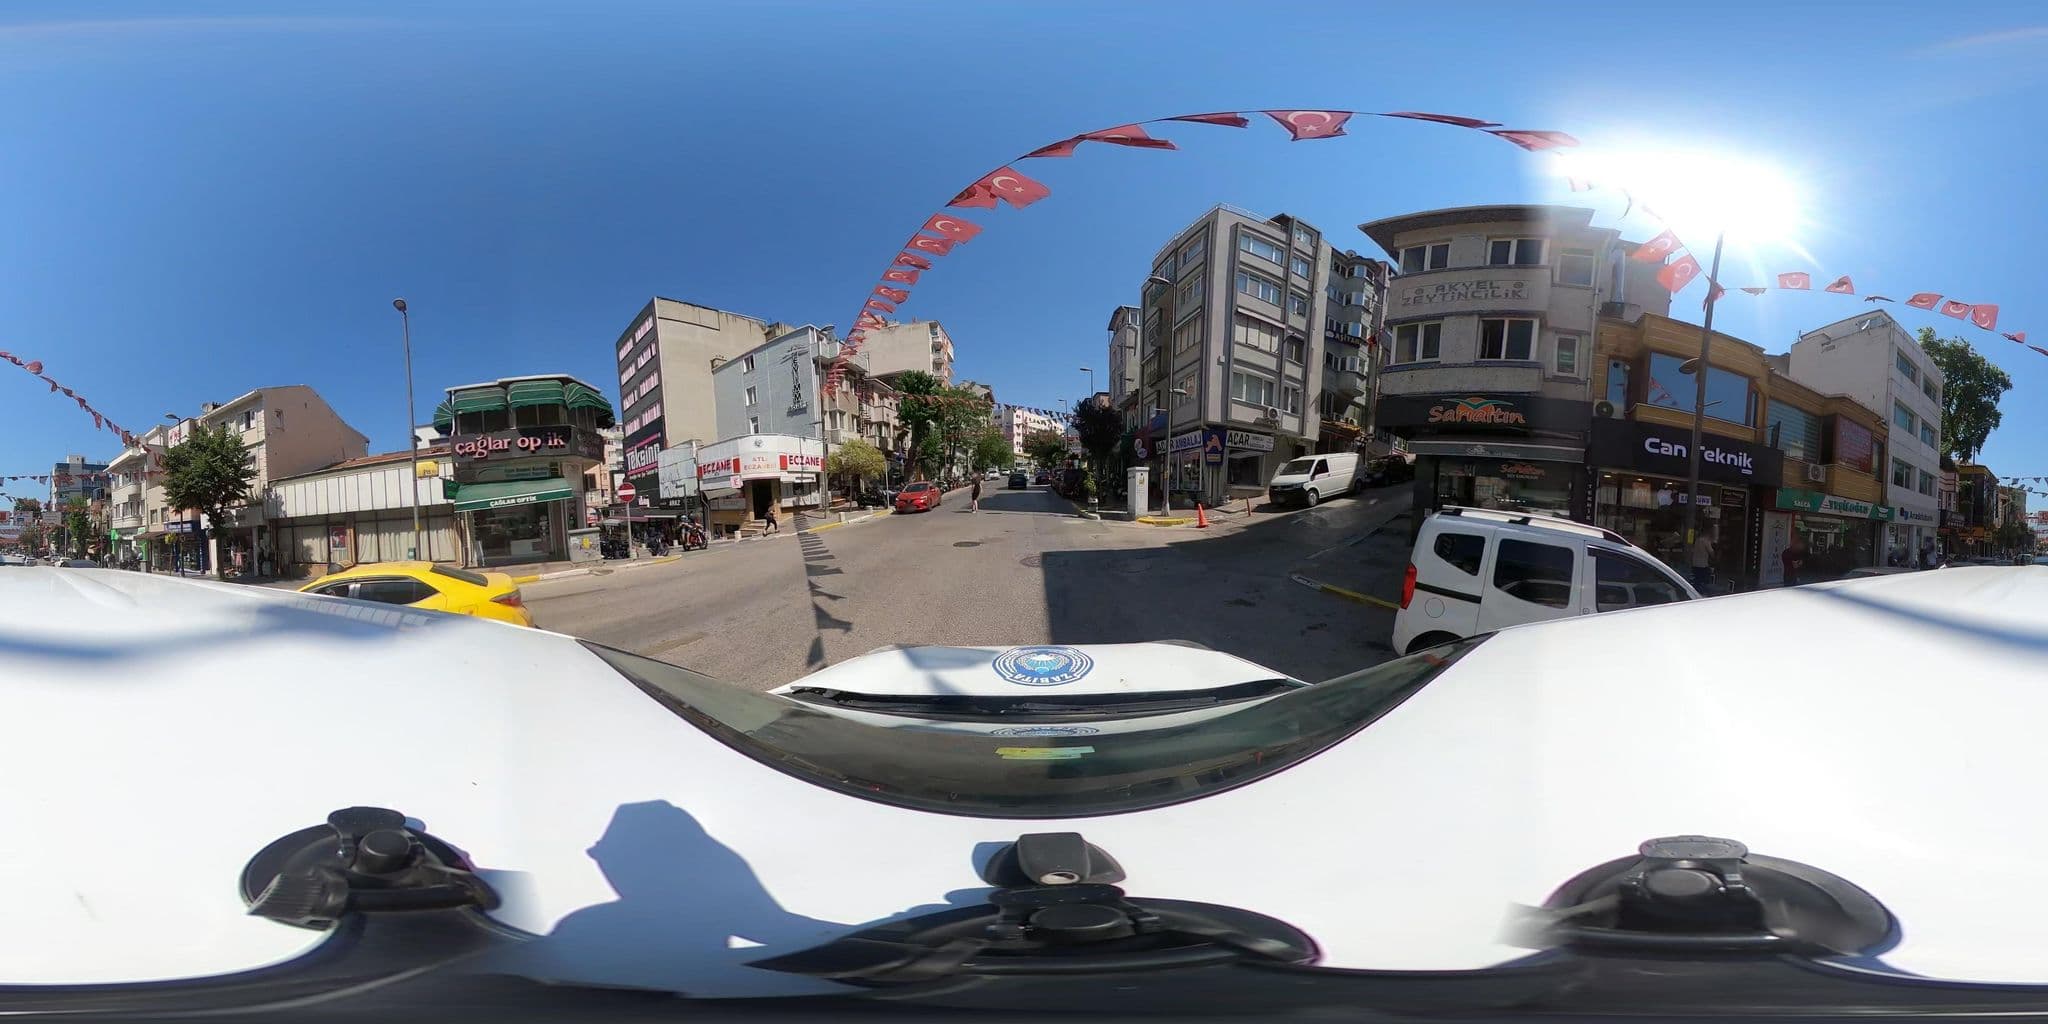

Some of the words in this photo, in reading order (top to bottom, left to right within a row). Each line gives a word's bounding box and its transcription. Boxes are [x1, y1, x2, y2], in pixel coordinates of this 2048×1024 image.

[1435, 280, 1500, 293] AKYEL
[455, 434, 512, 458] çağlar
[1228, 431, 1250, 446] ACAR
[1645, 437, 1687, 458] Can
[702, 460, 732, 475] ECZANE
[789, 455, 820, 466] ECZANE
